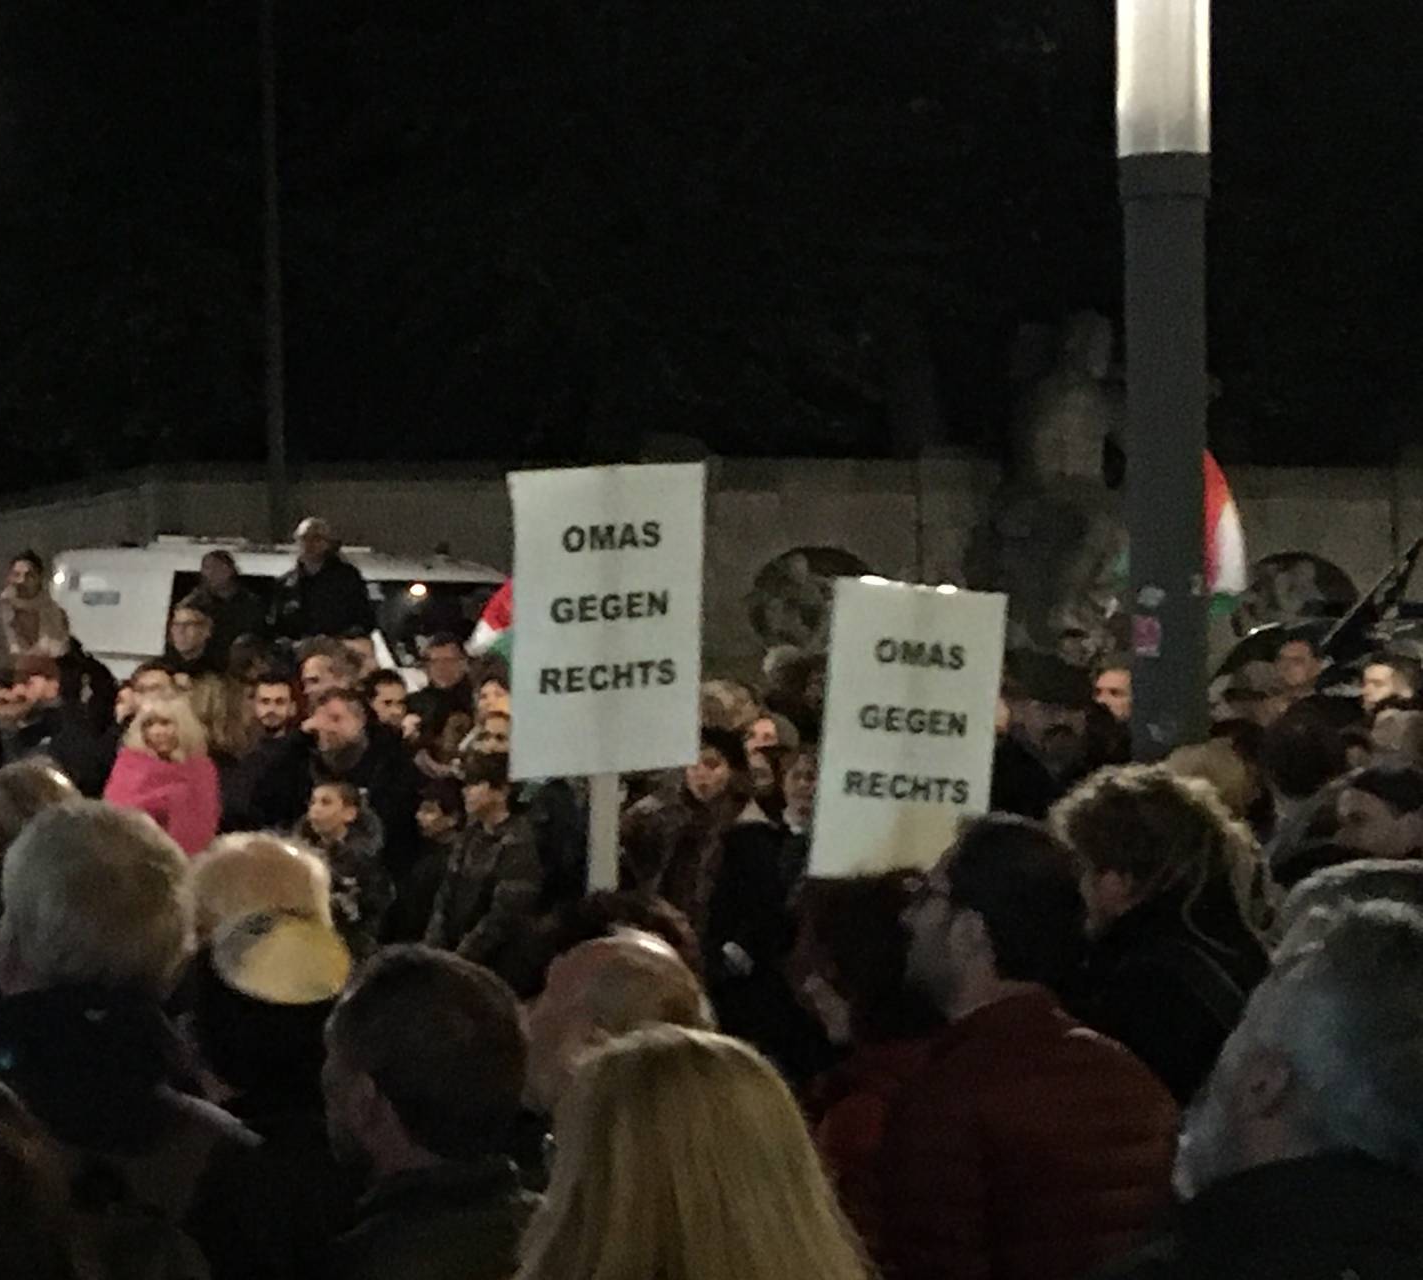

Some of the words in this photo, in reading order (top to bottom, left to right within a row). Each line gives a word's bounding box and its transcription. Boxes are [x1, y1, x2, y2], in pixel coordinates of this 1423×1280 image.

[562, 520, 662, 553] OMAS
[550, 590, 669, 624] GEGEN
[875, 638, 966, 670] OMAS
[539, 658, 676, 695] RECHTS
[858, 704, 968, 738] GEGEN
[843, 770, 970, 805] RECHTS
